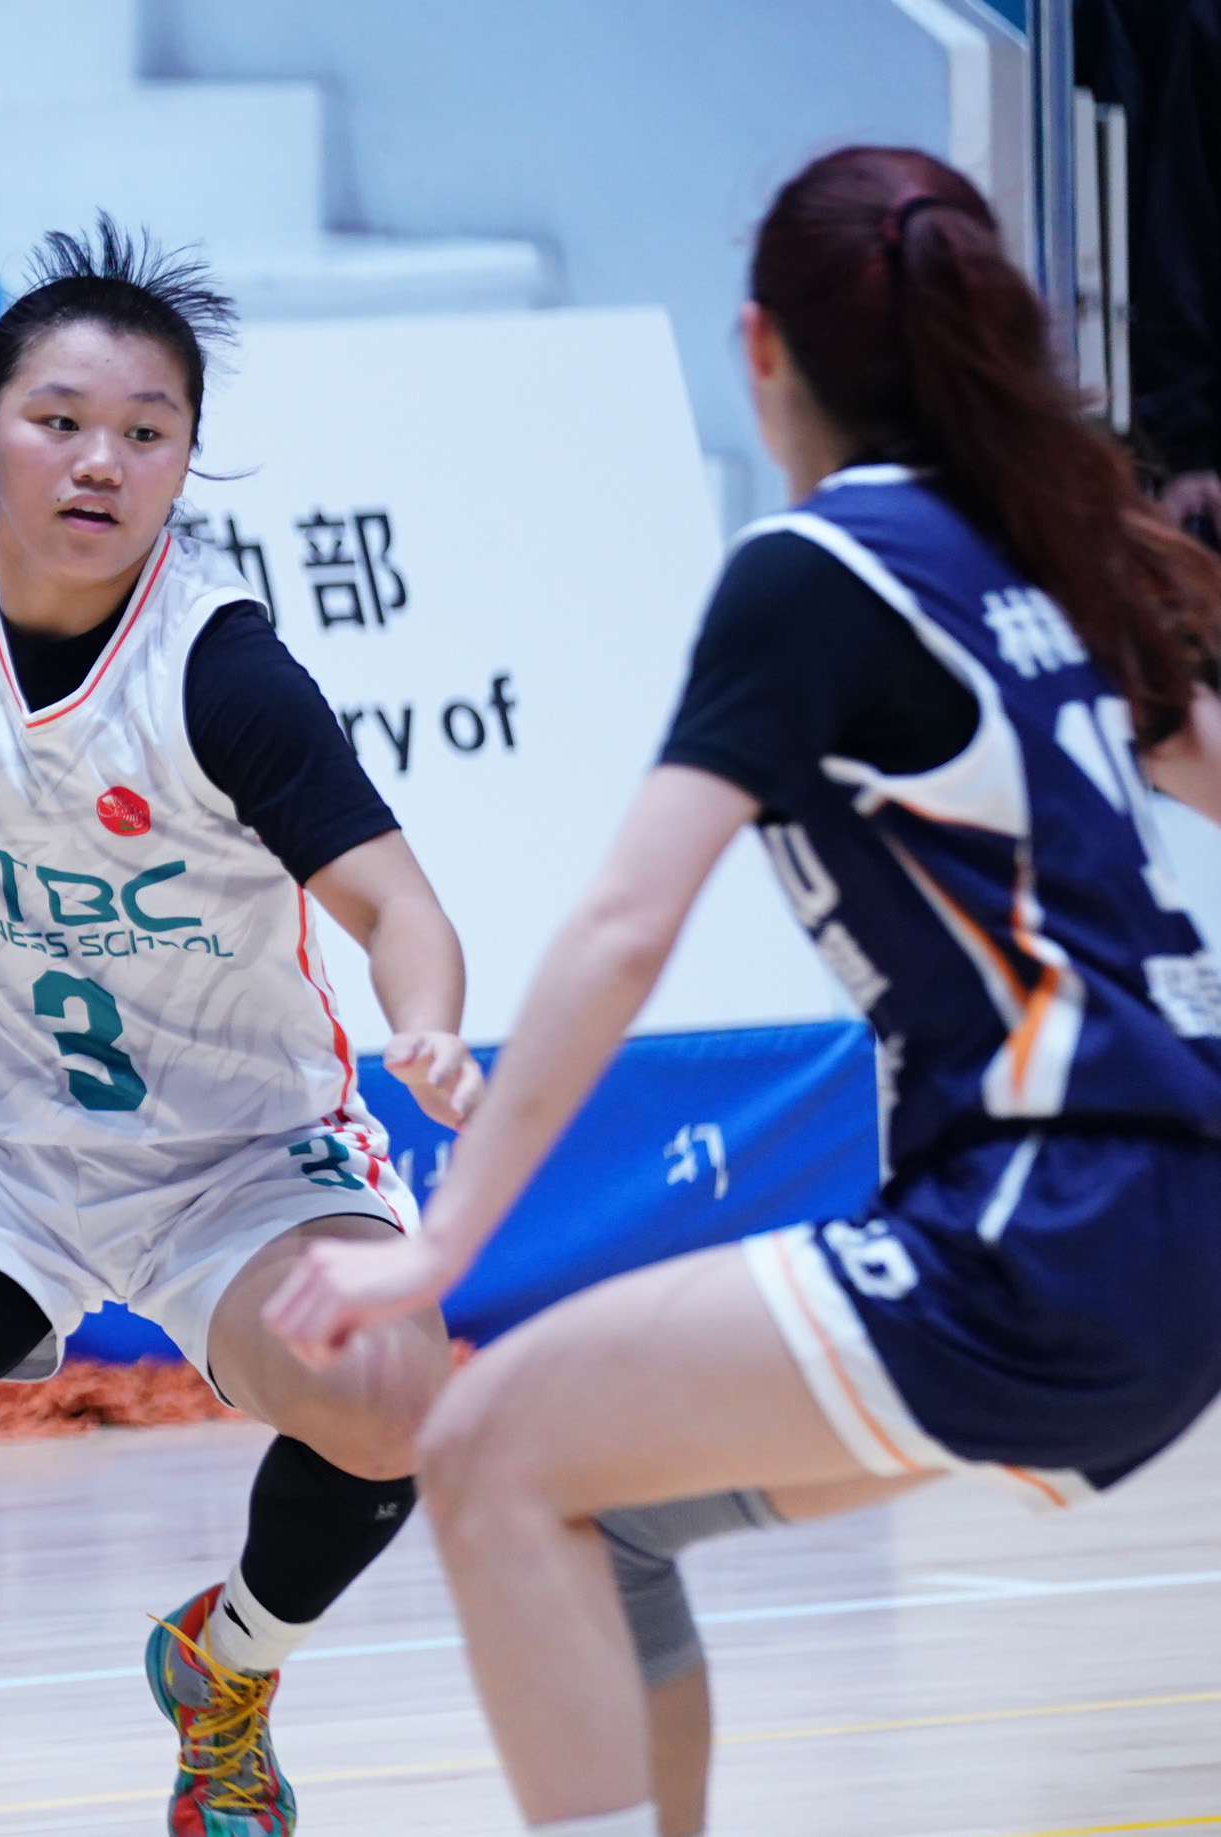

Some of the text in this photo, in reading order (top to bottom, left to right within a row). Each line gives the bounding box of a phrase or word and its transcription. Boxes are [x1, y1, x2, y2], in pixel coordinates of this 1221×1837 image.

[441, 670, 519, 754] of
[78, 928, 236, 959] SCHOL
[32, 969, 148, 1113] 3
[287, 1133, 365, 1191] 3
